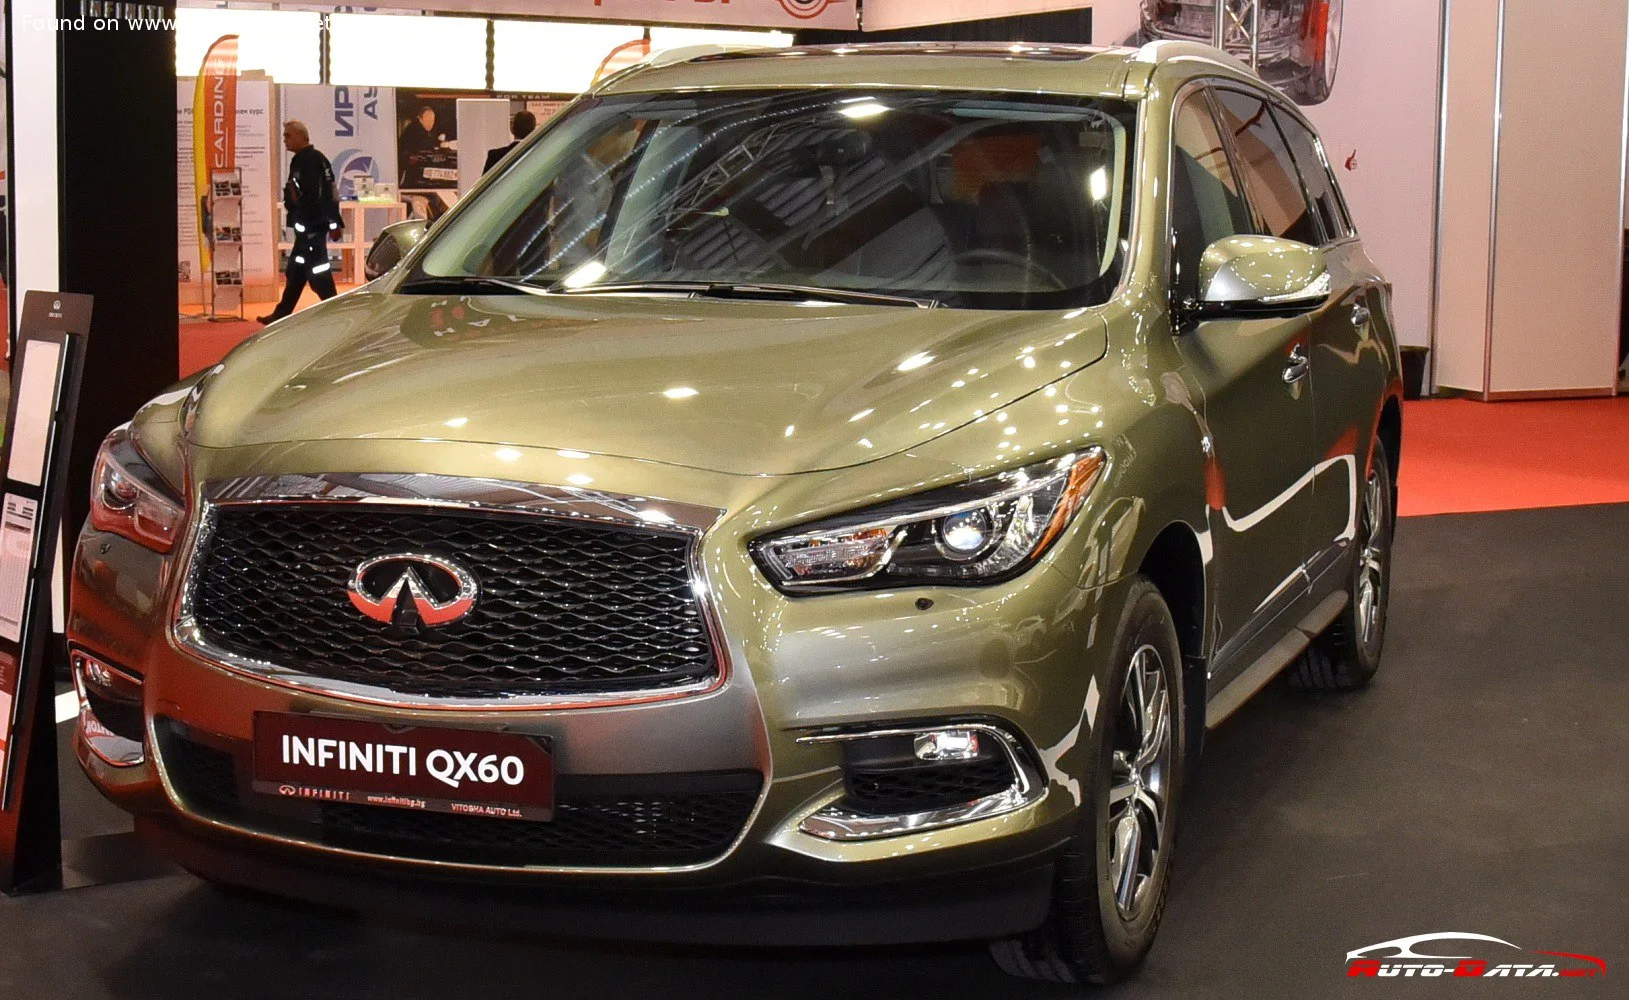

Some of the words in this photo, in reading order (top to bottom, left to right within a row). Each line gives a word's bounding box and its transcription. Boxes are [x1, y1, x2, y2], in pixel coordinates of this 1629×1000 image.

[281, 734, 417, 777] INFINITI
[425, 747, 525, 789] QX60
[298, 787, 350, 801] INFINITI
[451, 803, 484, 814] VITOSHA
[485, 806, 507, 816] AUTO
